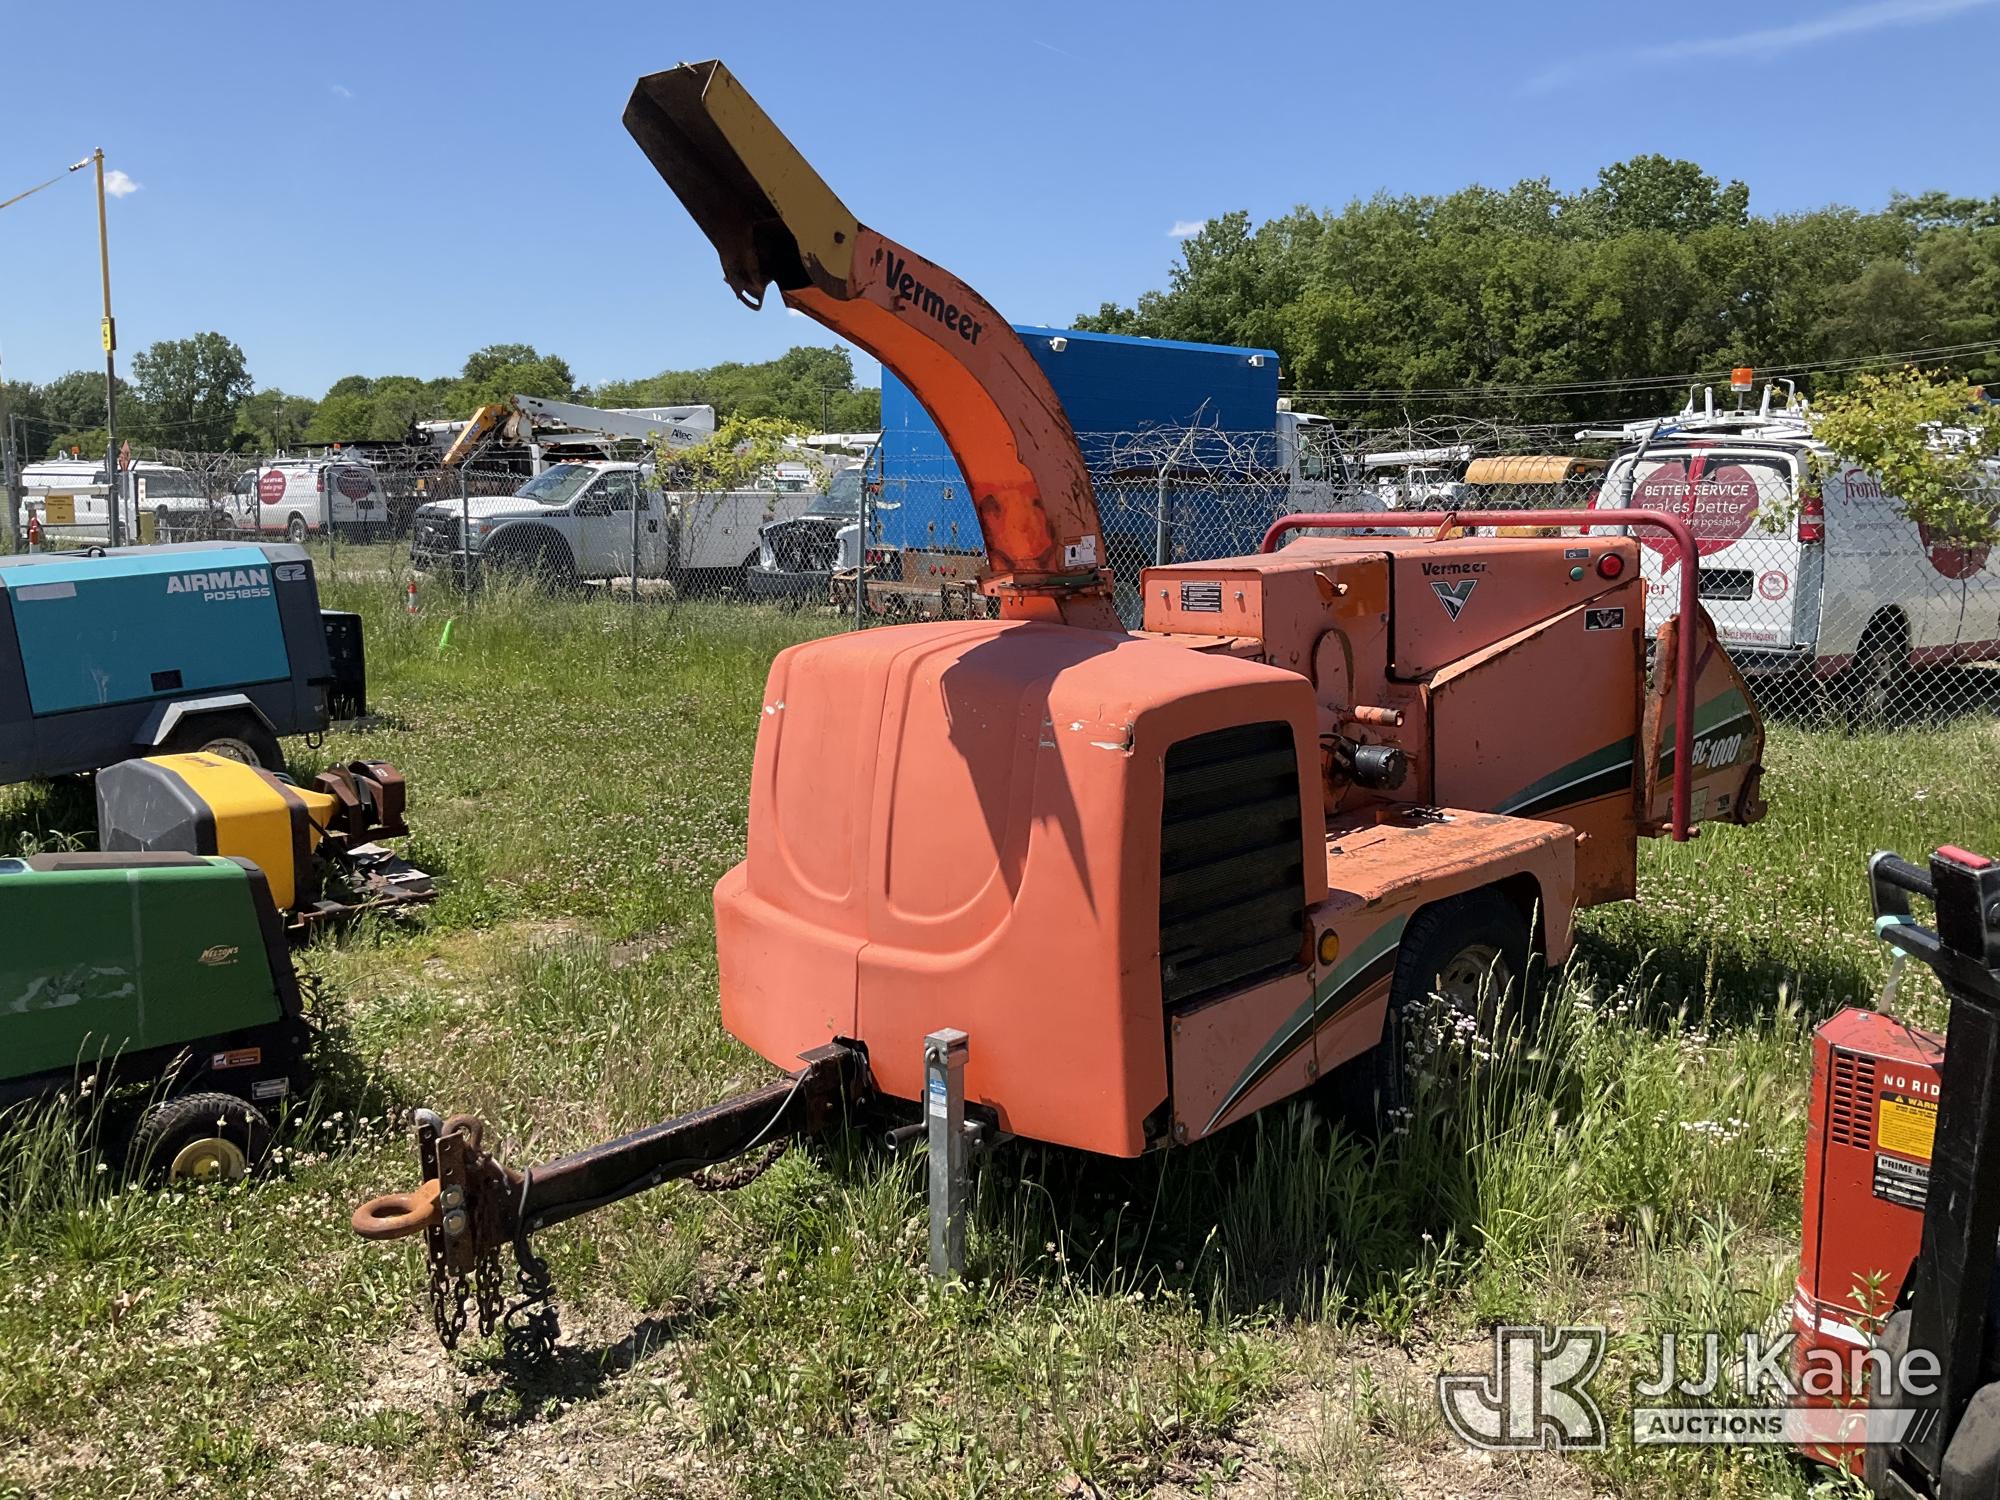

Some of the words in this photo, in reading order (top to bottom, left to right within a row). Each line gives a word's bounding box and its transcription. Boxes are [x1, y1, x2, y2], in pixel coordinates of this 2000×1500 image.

[886, 250, 982, 346] Vermeer
[671, 428, 693, 441] Altec
[1644, 484, 1691, 497] BETTER
[1693, 484, 1750, 497] SERVICE
[1843, 468, 1890, 506] front
[1642, 498, 1690, 514] makes
[1694, 498, 1747, 514] better
[1701, 516, 1741, 528] possible
[1421, 562, 1488, 577] Vermeer
[166, 568, 269, 594] AIRMAN
[204, 587, 271, 602] PDS185S
[1883, 1073, 1906, 1088] NO
[1911, 1079, 1940, 1096] RID
[1908, 1097, 1939, 1111] WARN
[1881, 1158, 1913, 1174] PRIME
